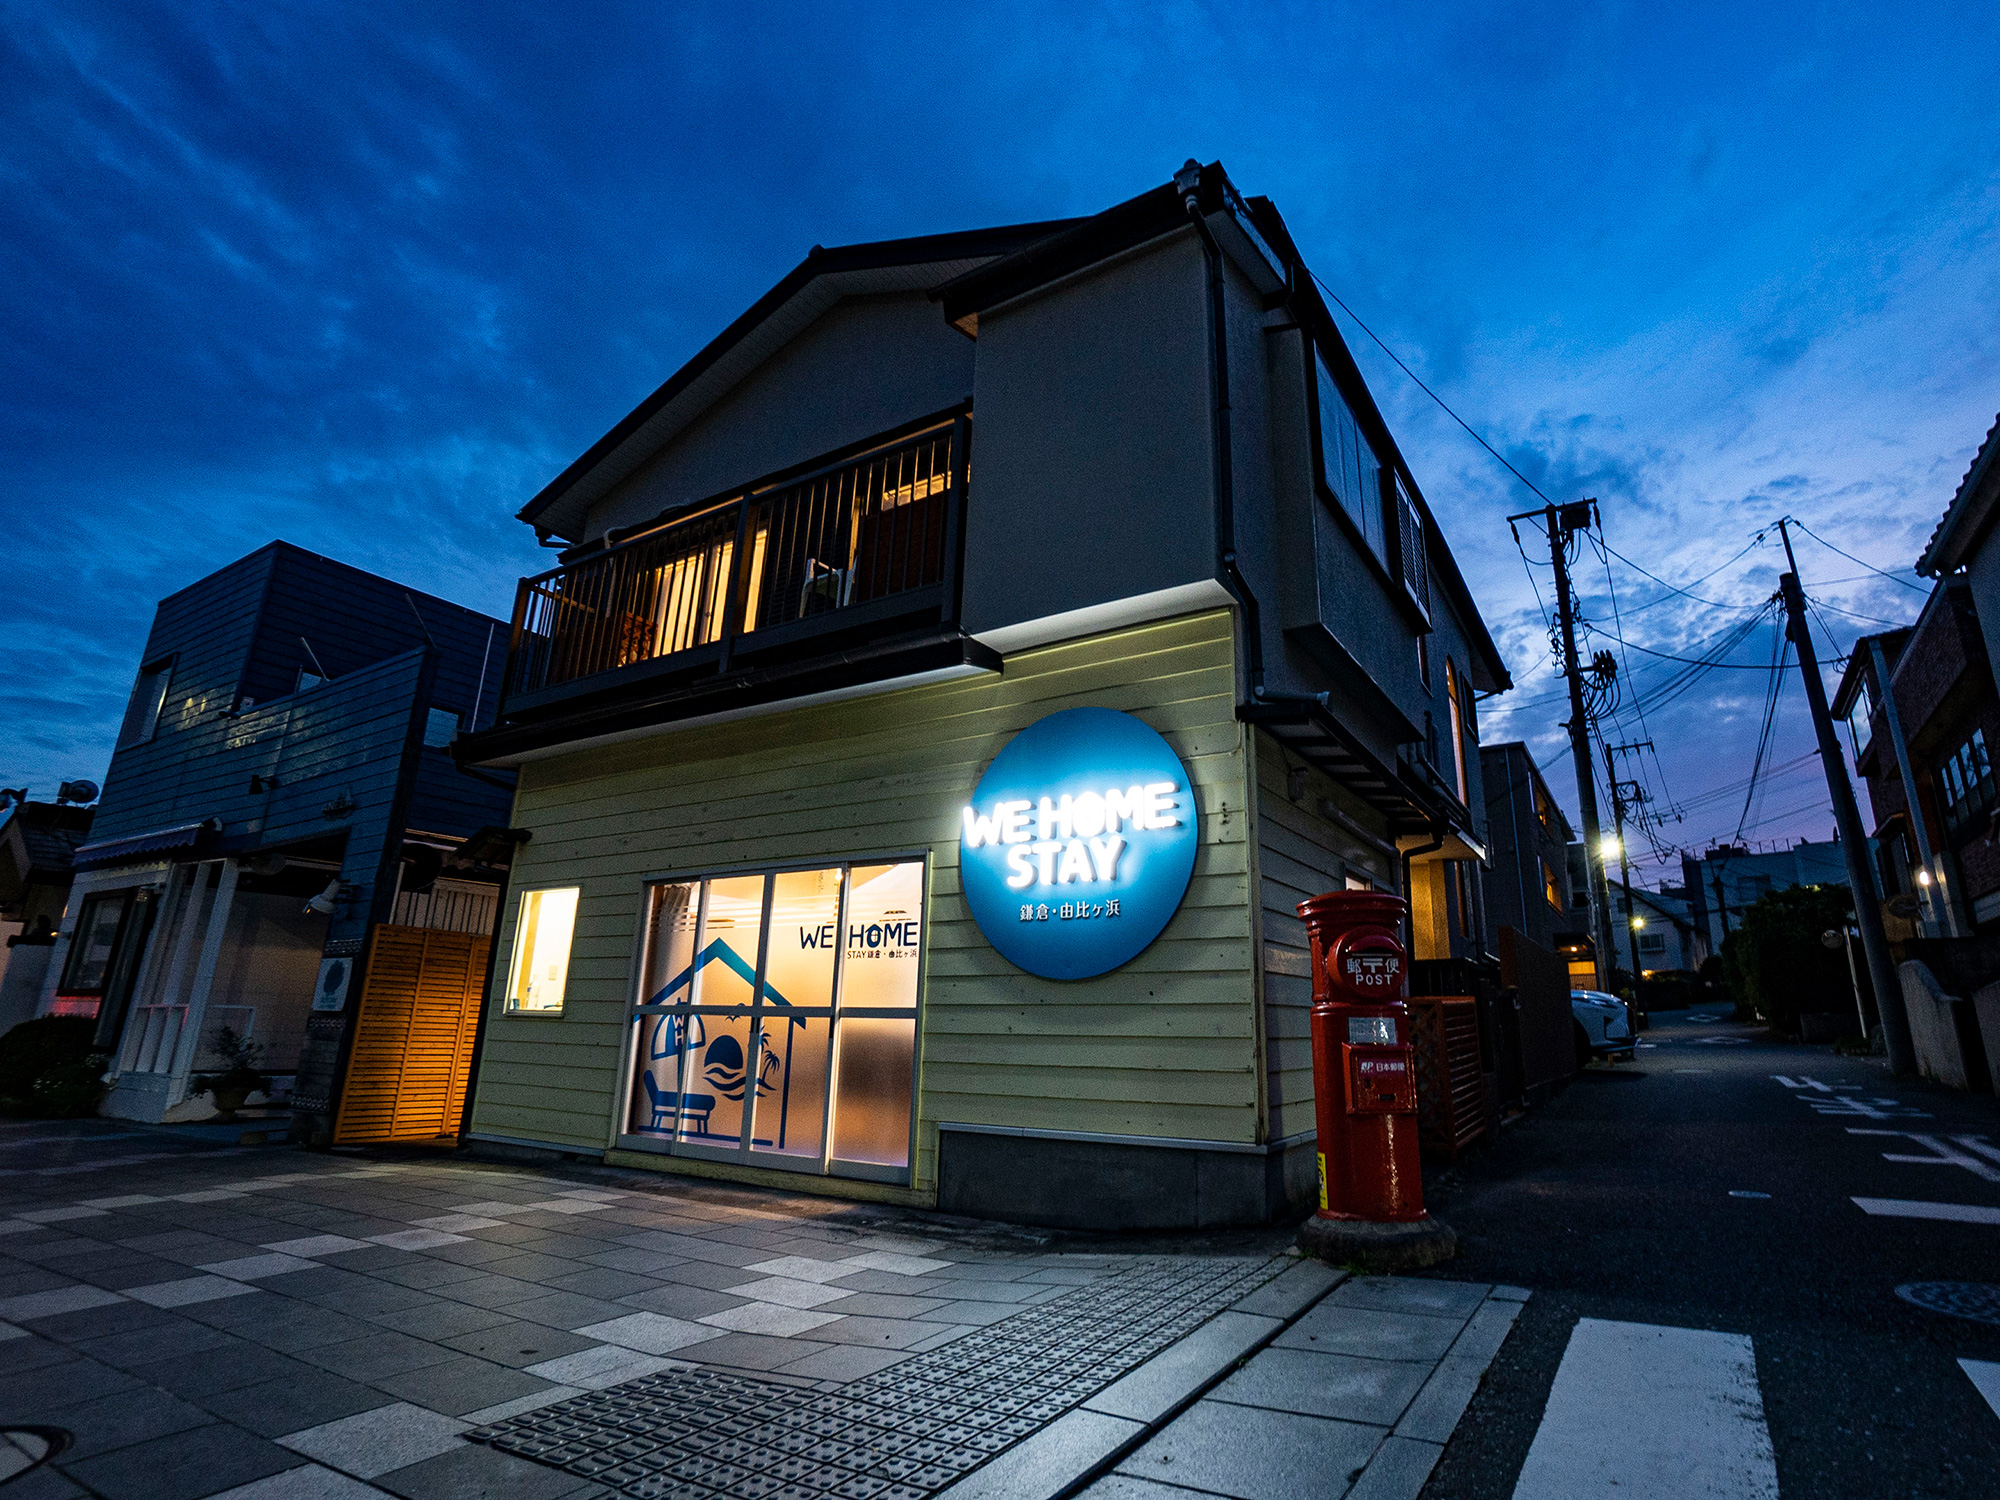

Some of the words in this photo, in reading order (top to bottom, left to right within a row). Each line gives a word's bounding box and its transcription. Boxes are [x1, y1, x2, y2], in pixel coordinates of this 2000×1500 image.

[963, 800, 1036, 847] WE
[1039, 782, 1181, 839] HOME
[1007, 835, 1126, 888] STAY
[800, 925, 835, 949] WE
[848, 922, 918, 949] HOME
[1355, 974, 1394, 986] POST
